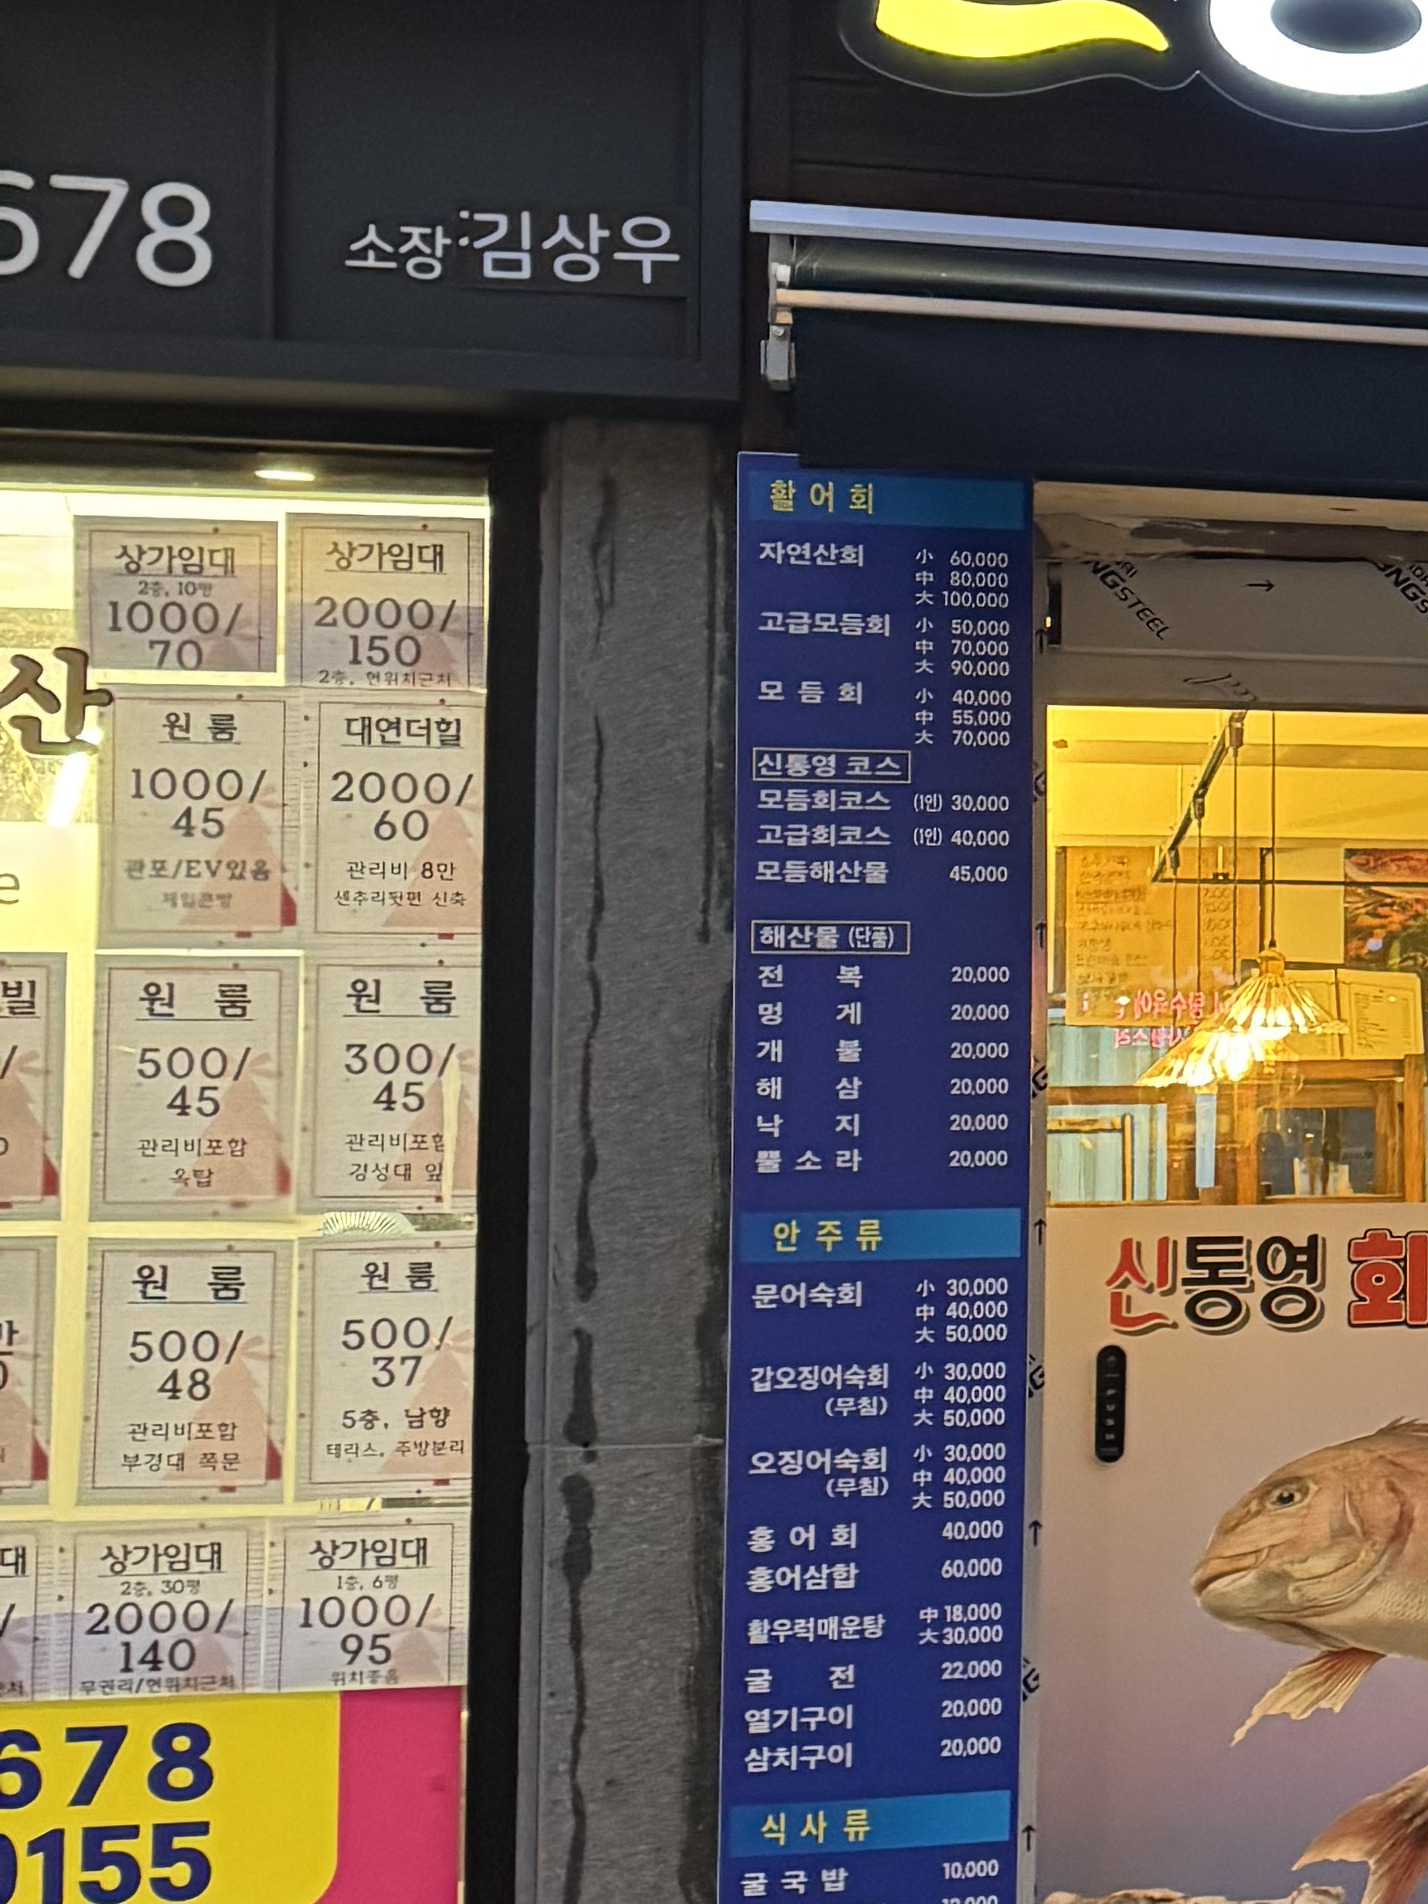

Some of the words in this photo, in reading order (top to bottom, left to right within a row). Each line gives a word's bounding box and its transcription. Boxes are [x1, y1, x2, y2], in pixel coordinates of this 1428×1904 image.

[115, 545, 235, 575] 상가임대
[326, 541, 445, 573] 상가임대
[760, 542, 863, 566] 자연산회
[950, 551, 1008, 567] 60,000
[950, 571, 1008, 587] 80,000
[942, 591, 1009, 608] 100,000
[109, 601, 242, 637] 1000/
[315, 597, 461, 637] 2000/
[759, 612, 890, 636] 고급모듬회
[952, 620, 1009, 636] 50,000
[148, 639, 204, 671] 70
[348, 634, 423, 667] 150
[952, 690, 1011, 706] 40,000
[345, 717, 463, 748] 대연더힐
[953, 710, 1011, 726] 55,000
[757, 752, 837, 778] 신통영
[846, 757, 901, 775] 코스
[132, 768, 266, 803] 1000/
[331, 771, 473, 806] 2000/
[758, 789, 891, 811] 모듬회코스
[952, 795, 1009, 811] 30,000
[172, 806, 224, 838] 45
[374, 810, 429, 841] 60
[757, 824, 891, 847] 고급회코스
[951, 830, 1009, 846] 40,000
[347, 861, 407, 880] 관리비
[421, 862, 455, 881] 8만
[756, 861, 888, 883] 모듬해산물
[950, 866, 1007, 882] 45,000
[760, 926, 839, 949] 해산물
[952, 967, 1009, 983] 20,000
[138, 1047, 251, 1081] 500/
[344, 1043, 457, 1077] 300/
[167, 1086, 220, 1117] 45
[373, 1081, 424, 1112] 45
[138, 1138, 248, 1157] 관리비포함
[752, 1281, 862, 1308] 문어숙회
[947, 1278, 1008, 1296] 30,000
[1105, 1233, 1326, 1333] 신통영
[946, 1301, 1008, 1319] 40,000
[130, 1330, 243, 1364] 500/
[341, 1316, 454, 1352] 500/
[158, 1368, 210, 1401] 48
[372, 1356, 422, 1387] 37
[751, 1363, 888, 1392] 갑오징어숙회
[945, 1362, 1006, 1381] 30,000
[405, 1407, 450, 1429] 남향
[826, 1396, 887, 1416] (무침)
[128, 1422, 237, 1442] 관리비포함
[122, 1452, 185, 1472] 부경대
[749, 1447, 886, 1475] 오징어숙회
[944, 1489, 1005, 1508] 50,000
[942, 1520, 1003, 1540] 40,000
[100, 1542, 223, 1575] 상가임대
[309, 1537, 429, 1569] 상가임대
[747, 1563, 858, 1592] 홍어삼합
[942, 1558, 1002, 1578] 60,000
[85, 1598, 235, 1636] 2000/
[299, 1593, 435, 1629] 1000/
[748, 1614, 885, 1644] 활우럭매운탕
[945, 1603, 1001, 1622] 18,000
[119, 1639, 196, 1674] 140
[340, 1634, 393, 1666] 95
[942, 1659, 1002, 1679] 22,000
[745, 1705, 852, 1733] 열기구이
[942, 1698, 1002, 1717] 20,000
[745, 1743, 852, 1772] 삼치구이
[943, 1859, 999, 1879] 10,000
